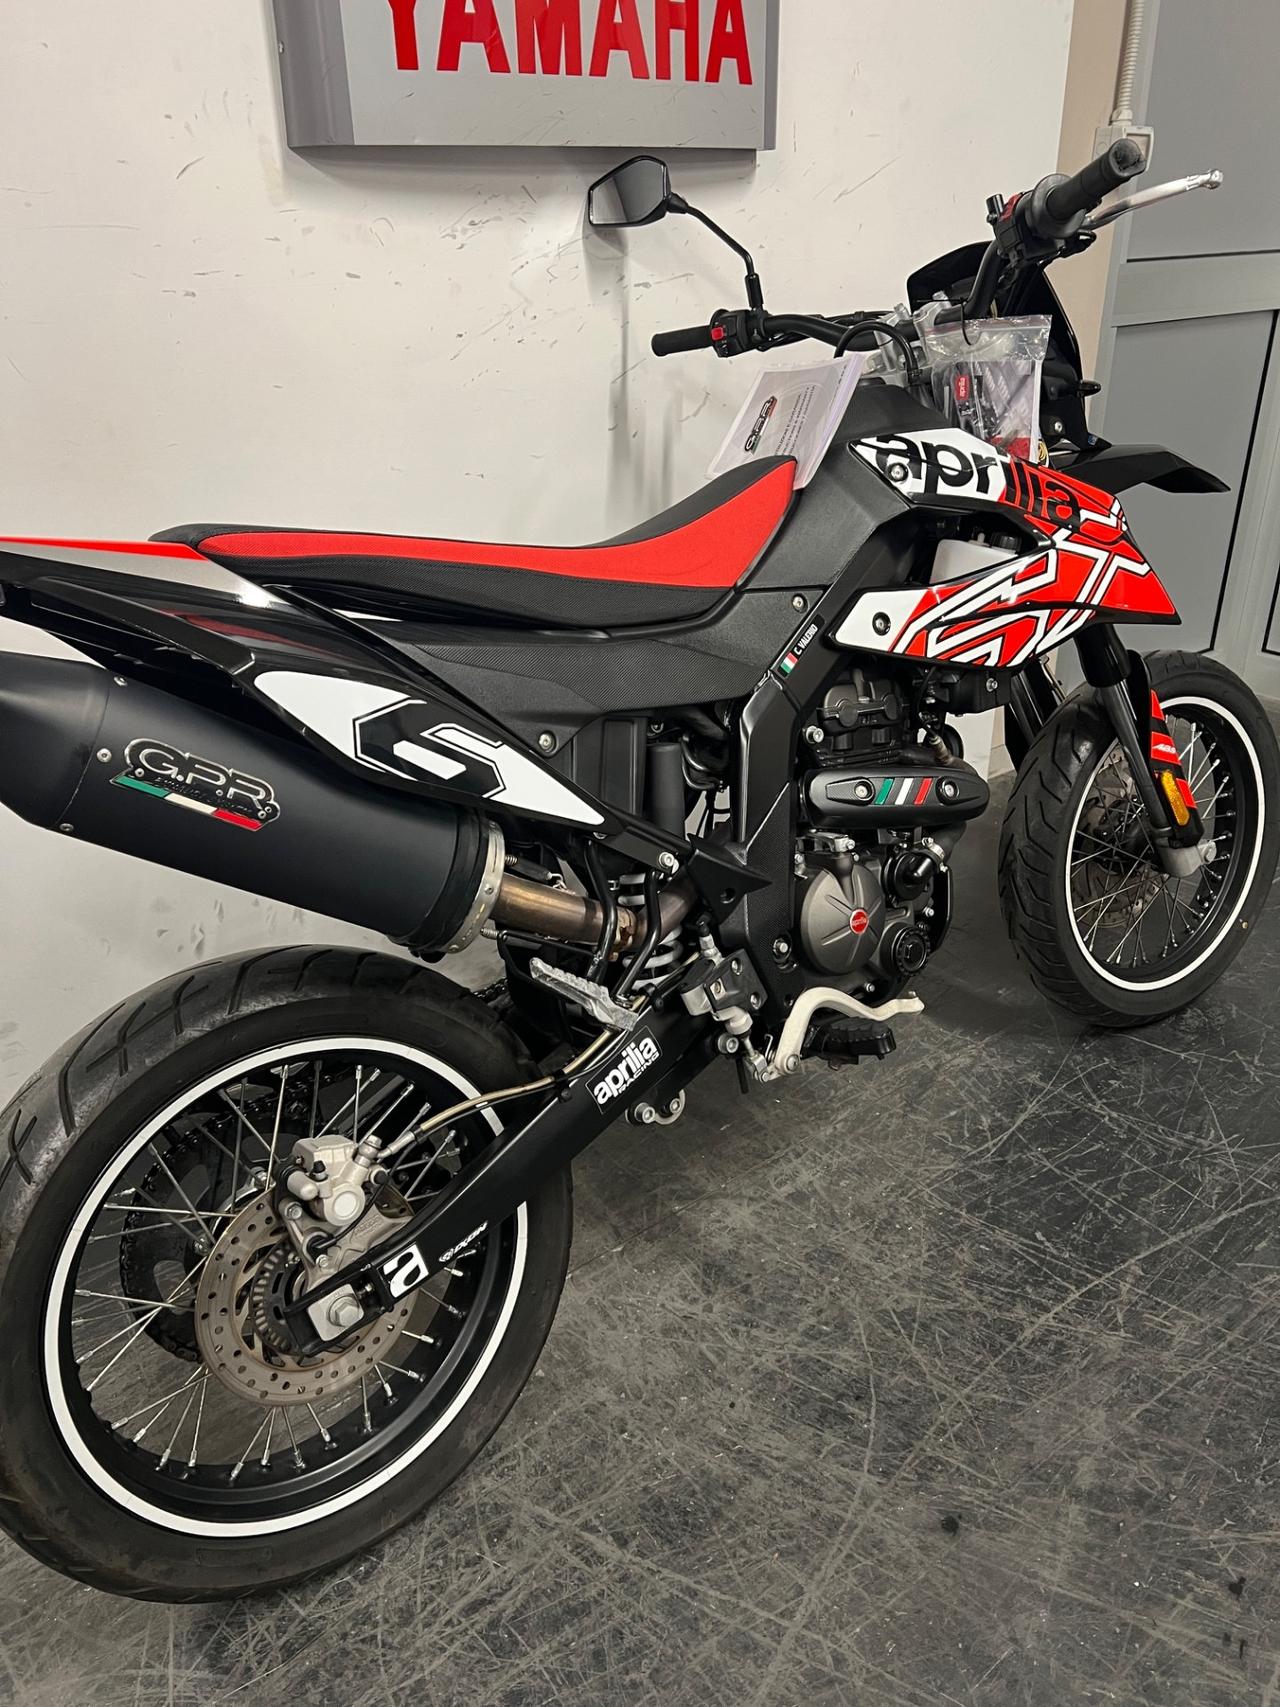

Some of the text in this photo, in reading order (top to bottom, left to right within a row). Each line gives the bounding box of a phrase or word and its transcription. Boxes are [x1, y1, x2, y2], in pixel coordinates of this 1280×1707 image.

[387, 0, 753, 85] YAMAHA
[875, 434, 1081, 528] aprilia
[593, 1037, 658, 1105] aprilia
